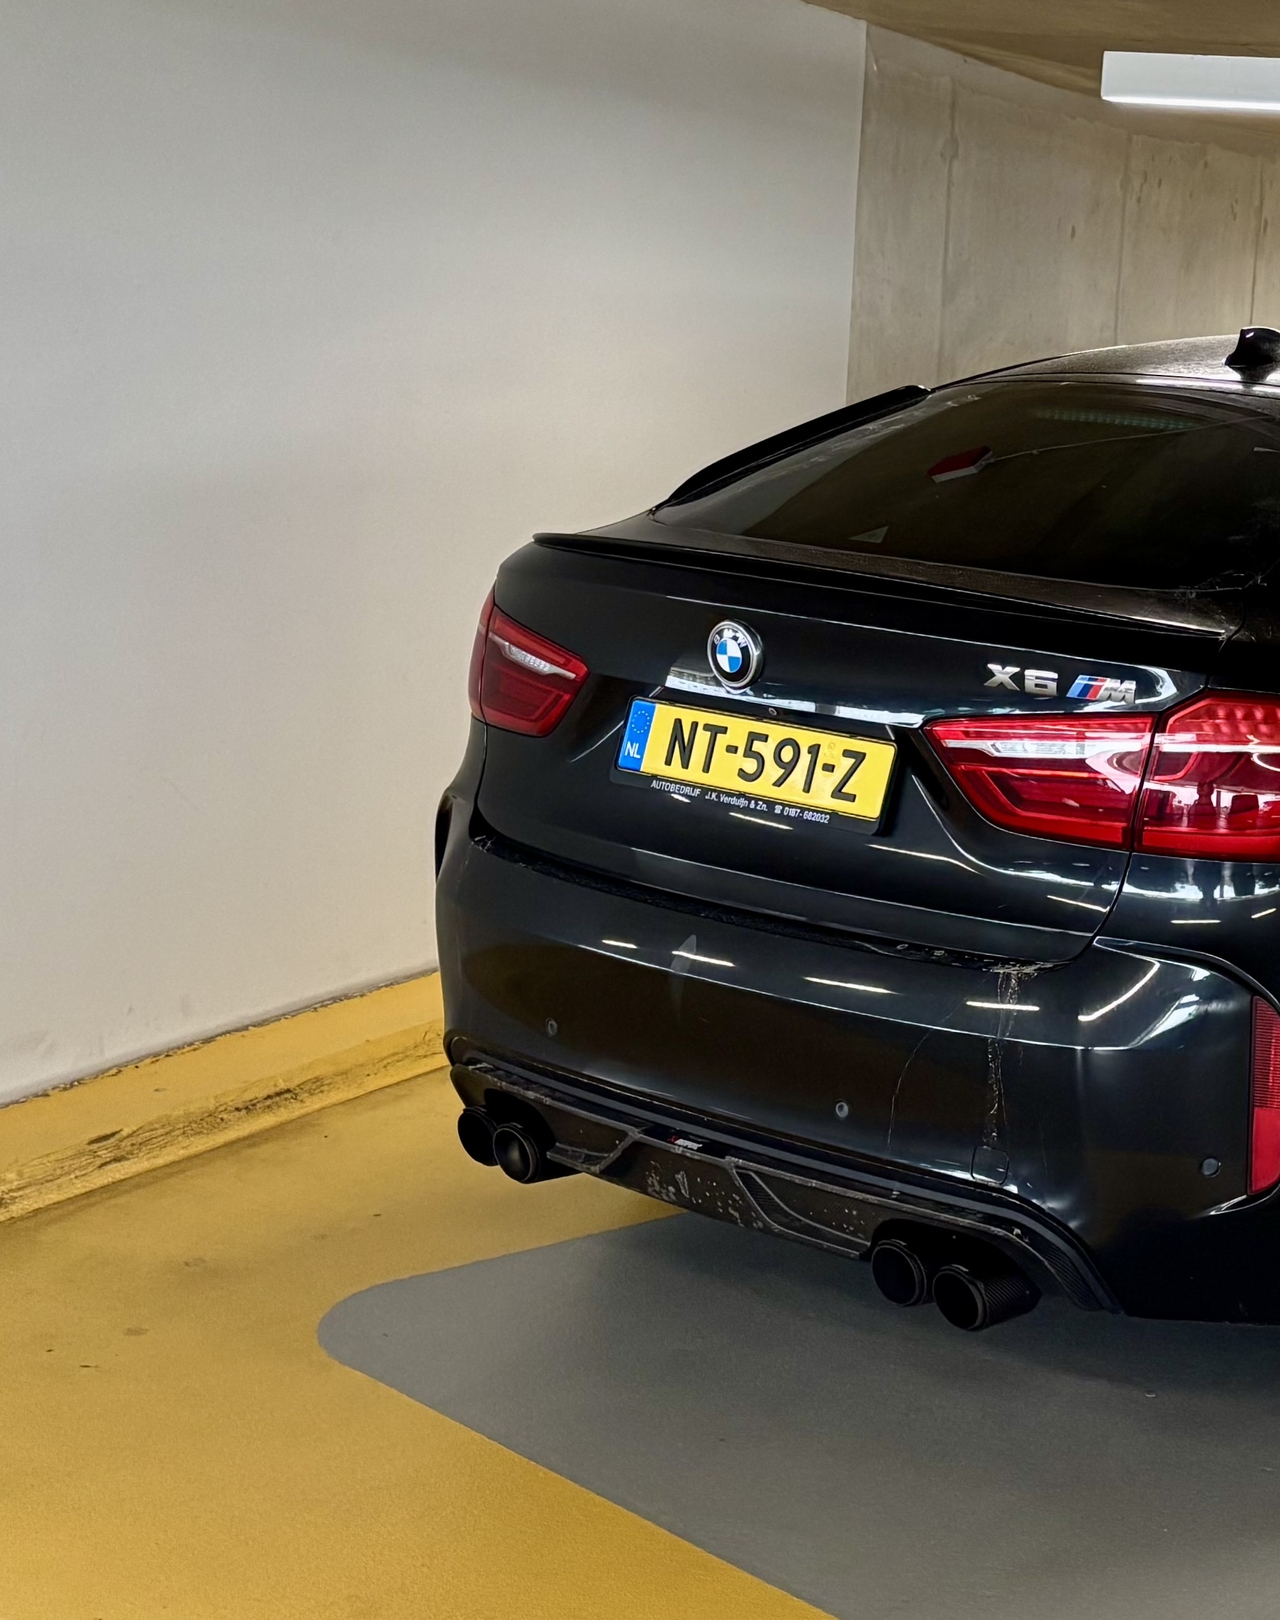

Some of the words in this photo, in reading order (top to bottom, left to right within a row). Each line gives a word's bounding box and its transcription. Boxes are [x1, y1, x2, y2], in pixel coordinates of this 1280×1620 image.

[984, 663, 1059, 697] X6
[624, 741, 641, 759] NL
[664, 717, 867, 803] NT-591-Z
[651, 780, 701, 798] AUTOBEDRIJF
[749, 800, 756, 809] &
